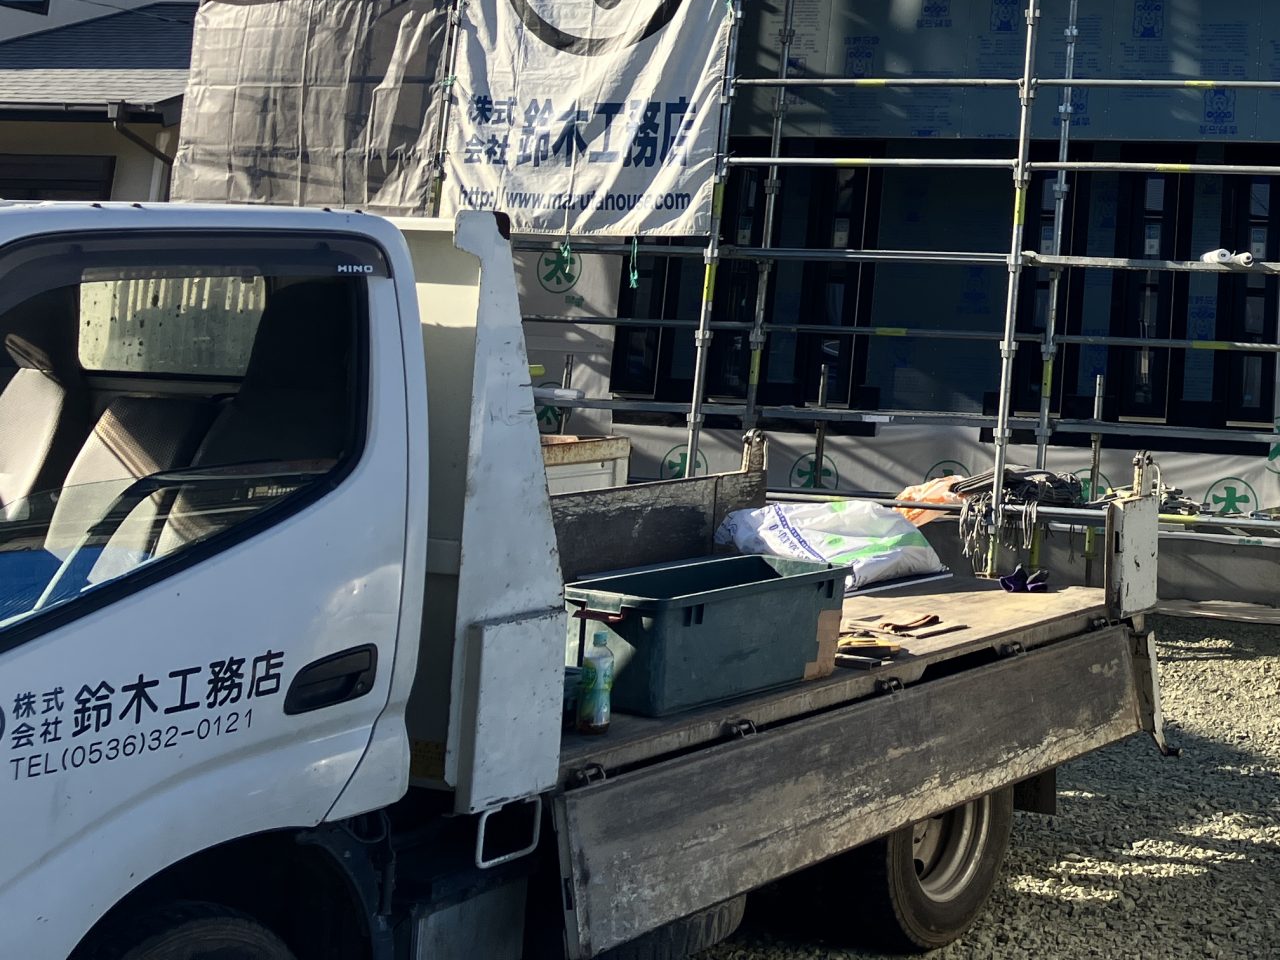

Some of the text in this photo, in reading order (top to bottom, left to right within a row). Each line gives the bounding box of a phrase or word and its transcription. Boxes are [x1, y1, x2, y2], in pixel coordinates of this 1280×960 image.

[468, 95, 517, 126] 株式
[516, 96, 697, 168] 鈴木工務店
[464, 133, 511, 166] 会社
[337, 265, 374, 273] HINO
[12, 686, 64, 720] 株式
[72, 649, 285, 737] 鈴木工務店
[10, 708, 253, 780] TEL(0536)32-0121
[11, 716, 62, 749] 会社
